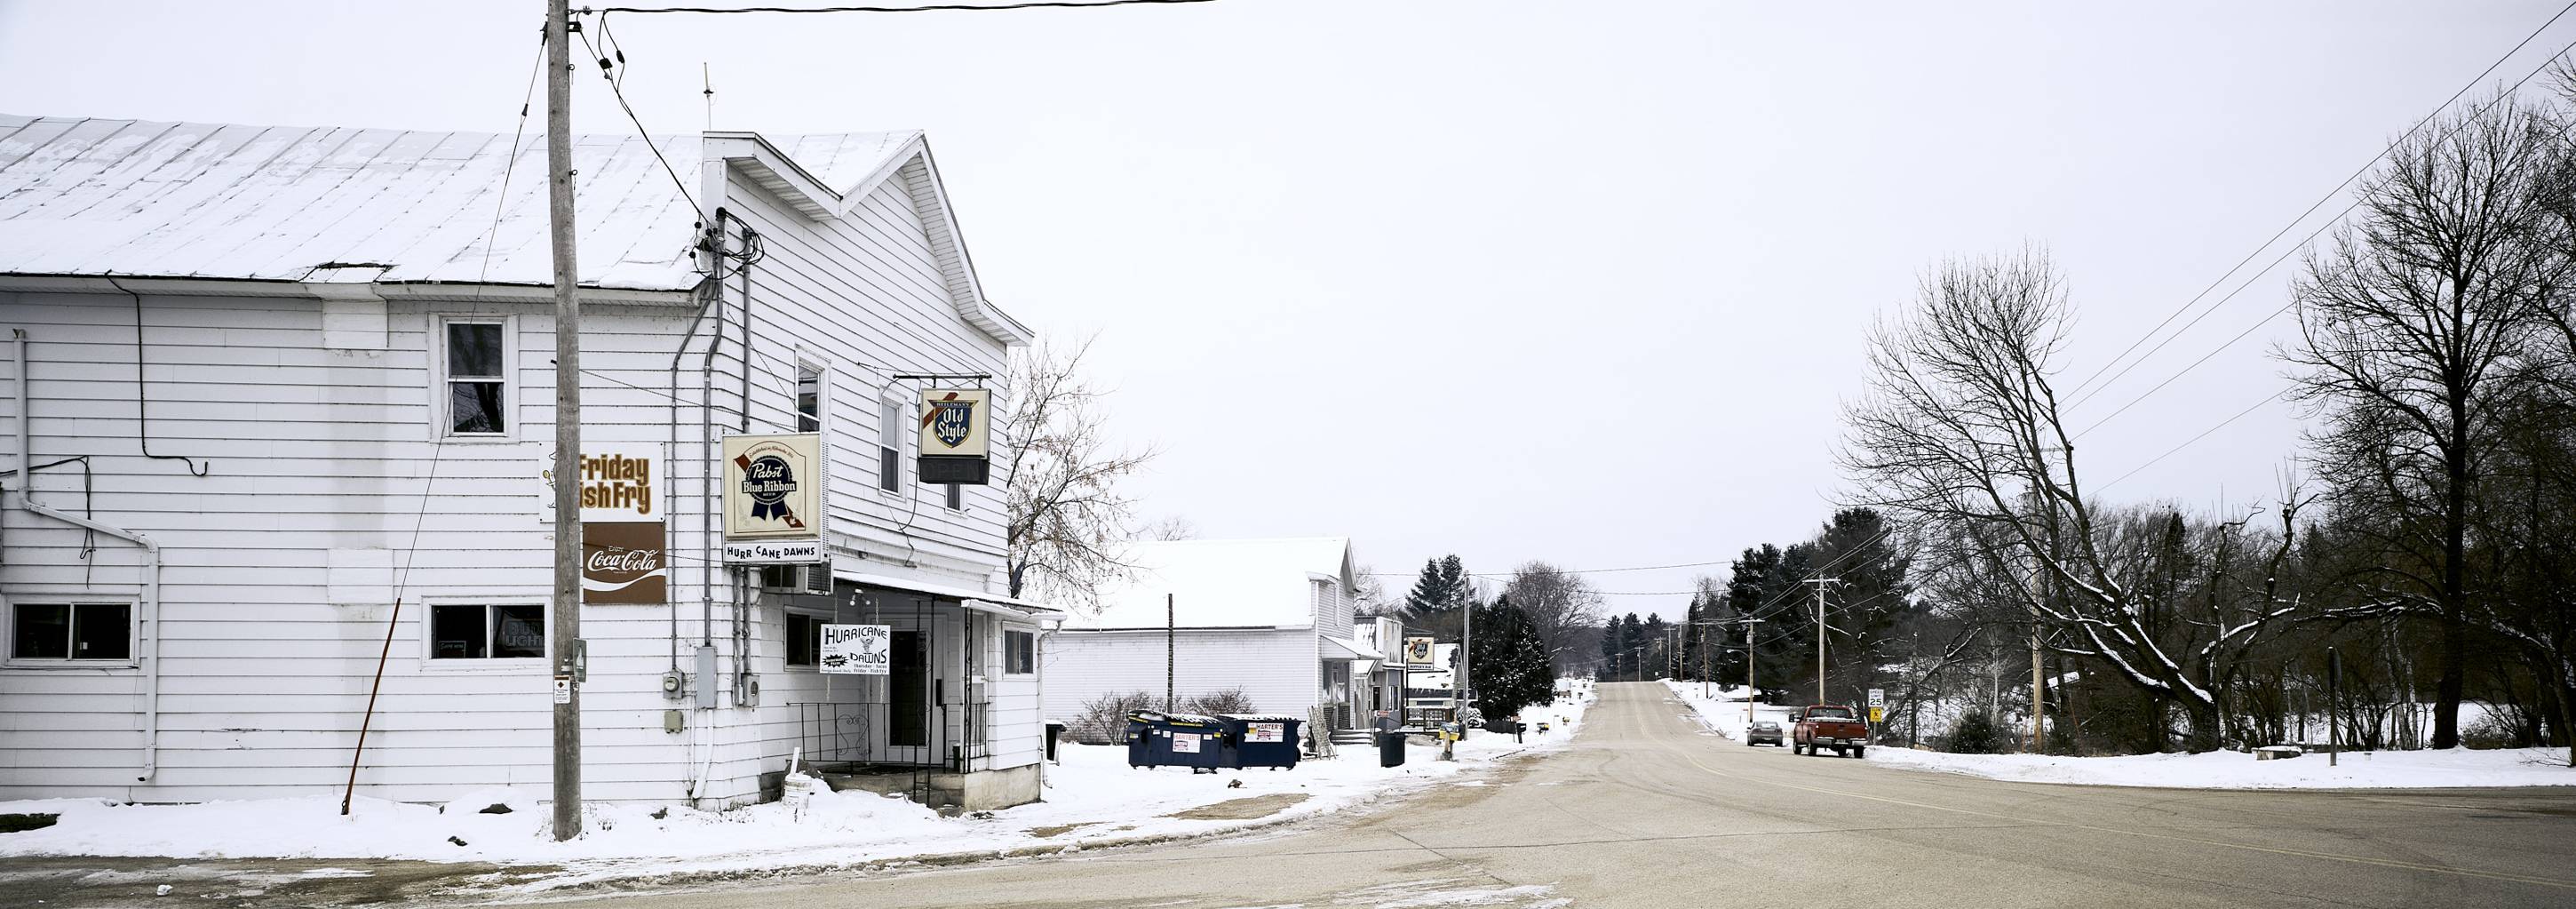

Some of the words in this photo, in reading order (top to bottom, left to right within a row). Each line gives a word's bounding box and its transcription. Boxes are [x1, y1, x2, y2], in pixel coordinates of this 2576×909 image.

[943, 409, 964, 423] Old
[937, 422, 967, 443] Style
[751, 463, 783, 479] Pabst
[743, 481, 763, 493] Blue
[764, 480, 796, 492] Ribbon
[580, 482, 612, 508] ish
[612, 482, 651, 514] Fry
[783, 547, 815, 556] DAWNS
[587, 549, 660, 571] Coca-Cola
[824, 626, 887, 645] HURRICANE
[849, 649, 887, 664] DAWNS
